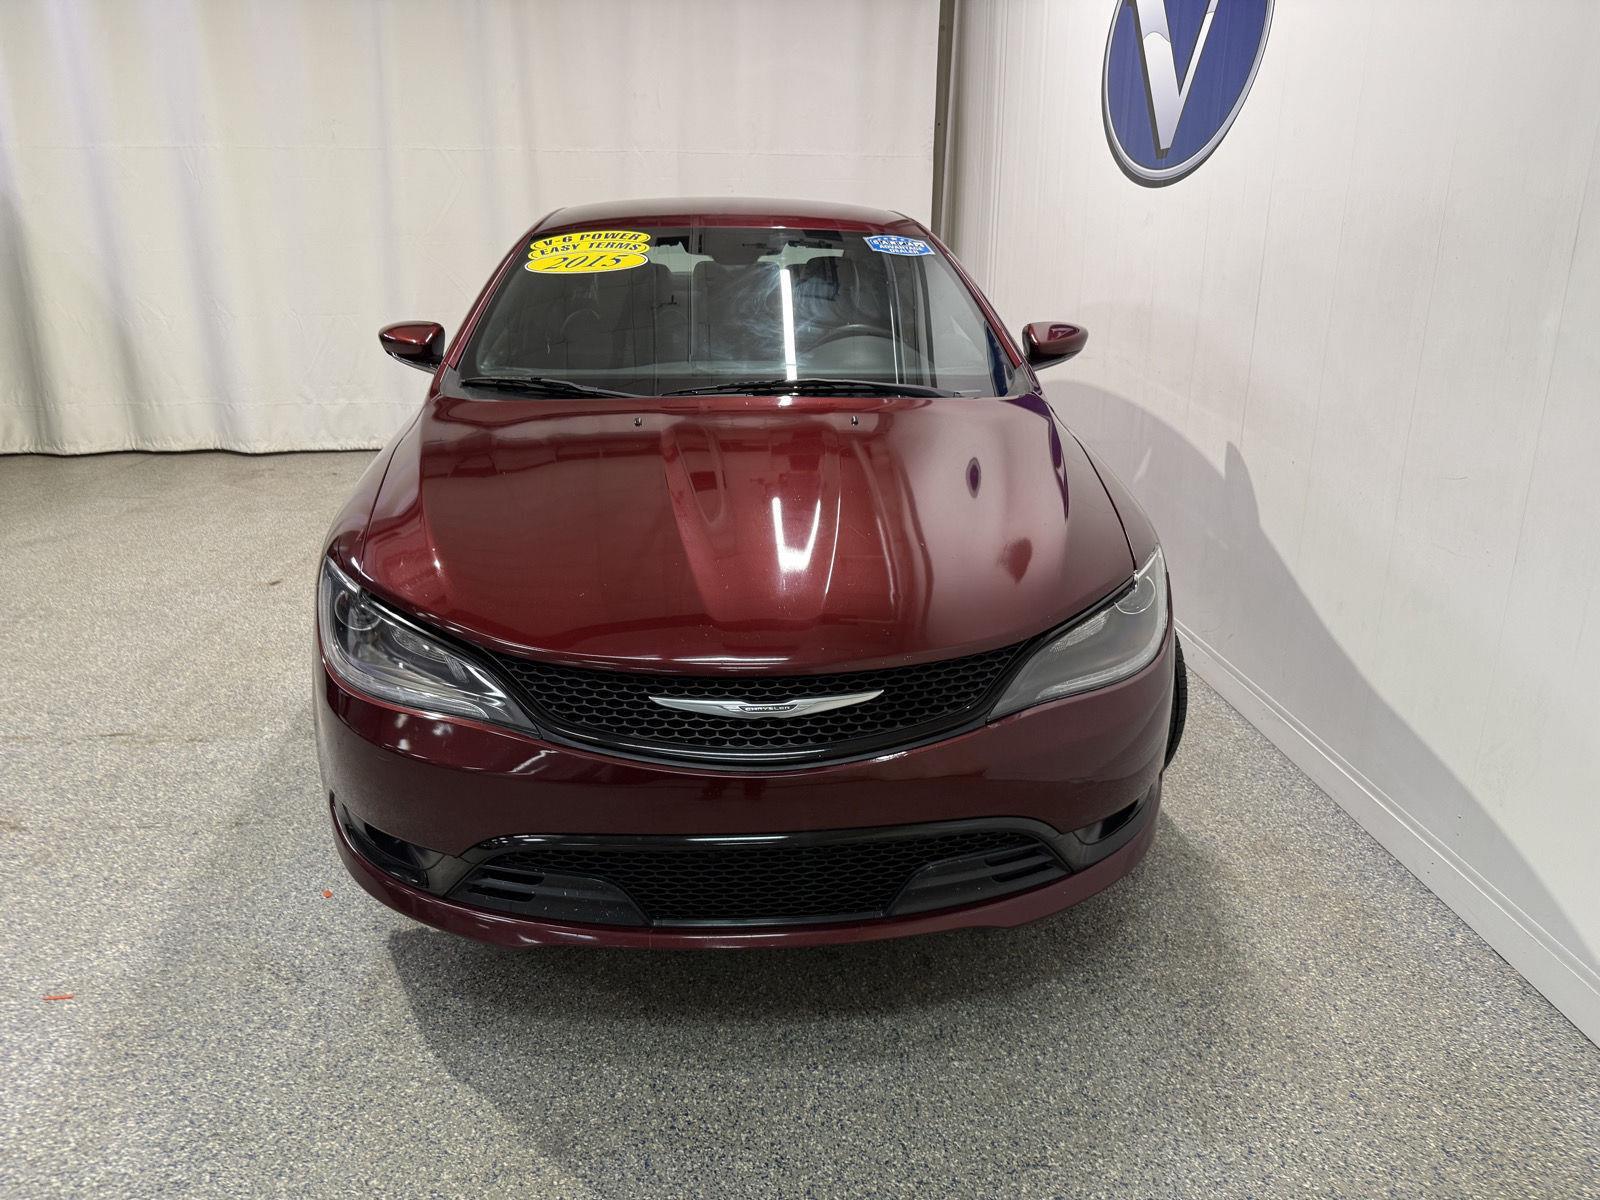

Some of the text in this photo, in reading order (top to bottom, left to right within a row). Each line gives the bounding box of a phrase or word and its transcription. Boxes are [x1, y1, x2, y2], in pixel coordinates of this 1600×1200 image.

[1136, 0, 1219, 150] V
[542, 232, 642, 246] V-6 POWER
[540, 242, 641, 256] EASY TERMS
[543, 255, 630, 270] 2015
